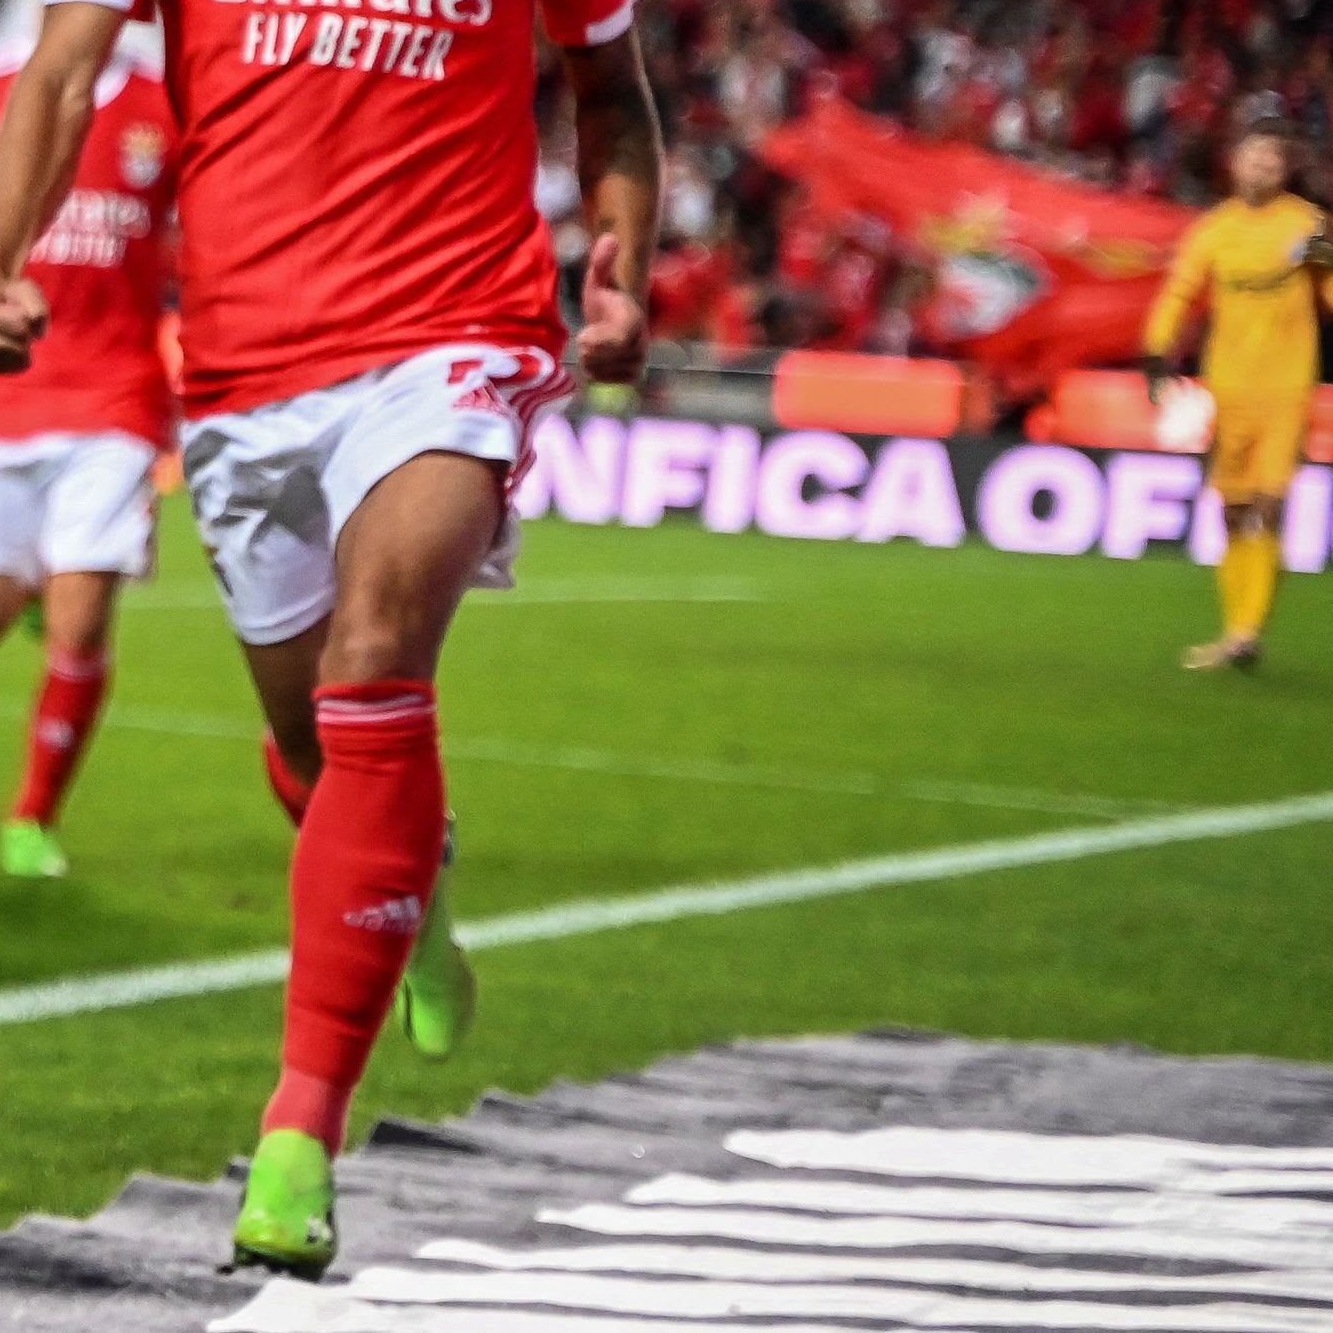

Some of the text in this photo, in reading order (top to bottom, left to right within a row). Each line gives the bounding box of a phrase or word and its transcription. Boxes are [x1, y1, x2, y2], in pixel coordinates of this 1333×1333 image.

[243, 13, 454, 81] FLY BETTER
[511, 411, 967, 548] NFICA
